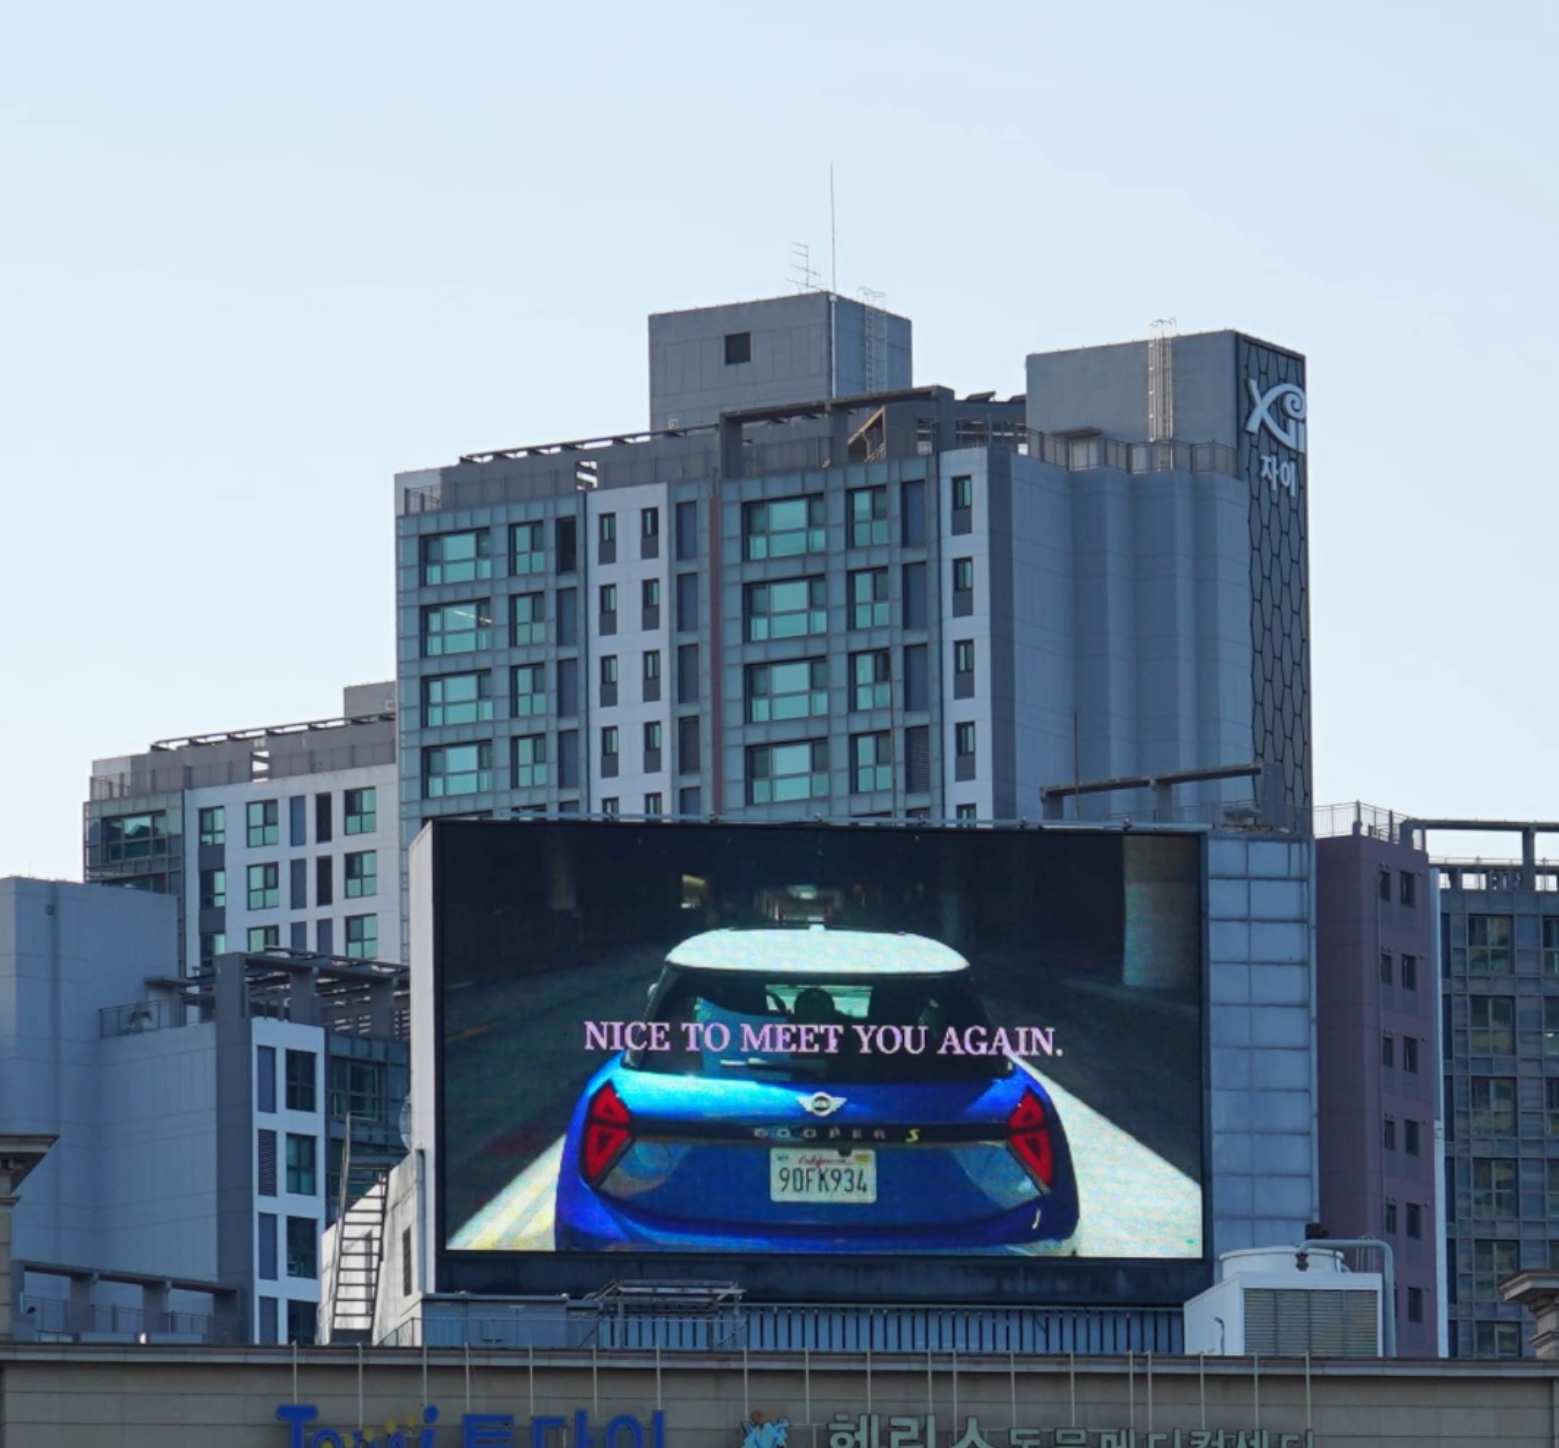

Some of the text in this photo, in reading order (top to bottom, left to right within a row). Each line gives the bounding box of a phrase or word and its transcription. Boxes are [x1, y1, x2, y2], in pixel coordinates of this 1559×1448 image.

[1260, 454, 1296, 497] 자이
[584, 1021, 1064, 1056] NICE TO MEET YOU AGAIN.
[754, 1126, 921, 1143] COOPER S
